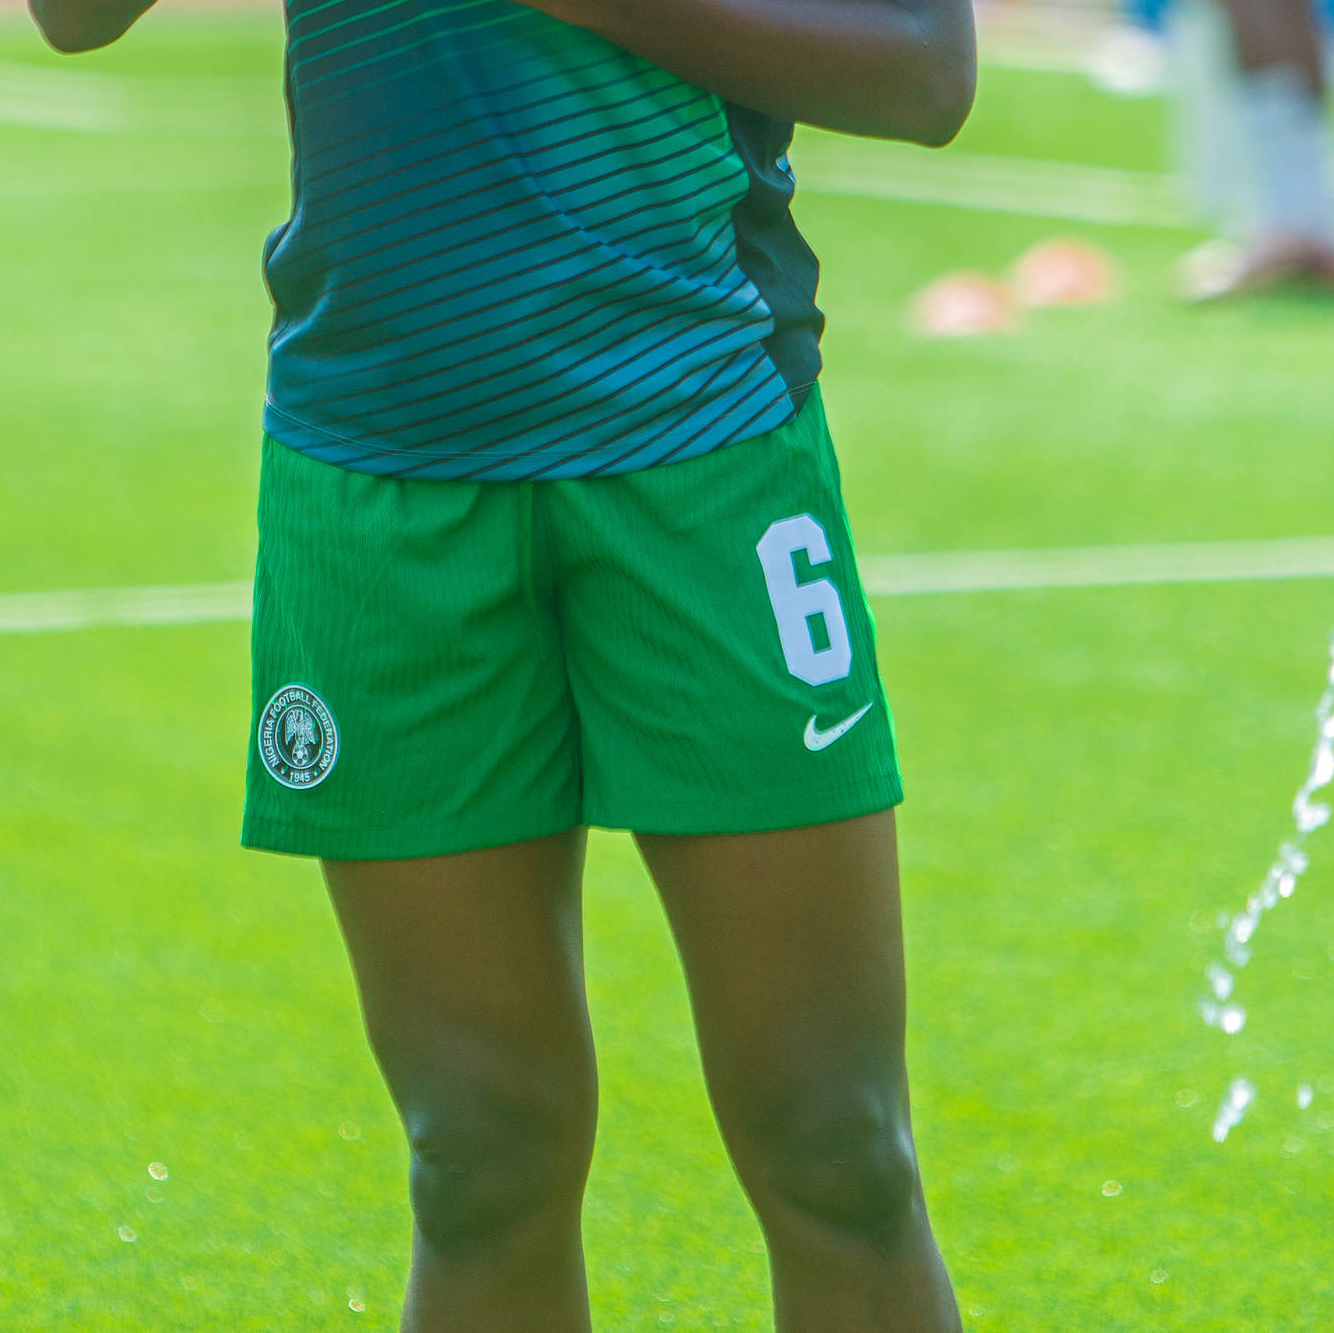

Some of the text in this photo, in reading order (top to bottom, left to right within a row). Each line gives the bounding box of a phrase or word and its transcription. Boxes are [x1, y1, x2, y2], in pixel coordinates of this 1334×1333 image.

[756, 513, 853, 687] 6
[264, 691, 334, 771] NIGERIA FOOTBALL FEDERATION
[289, 772, 310, 783] 1945
